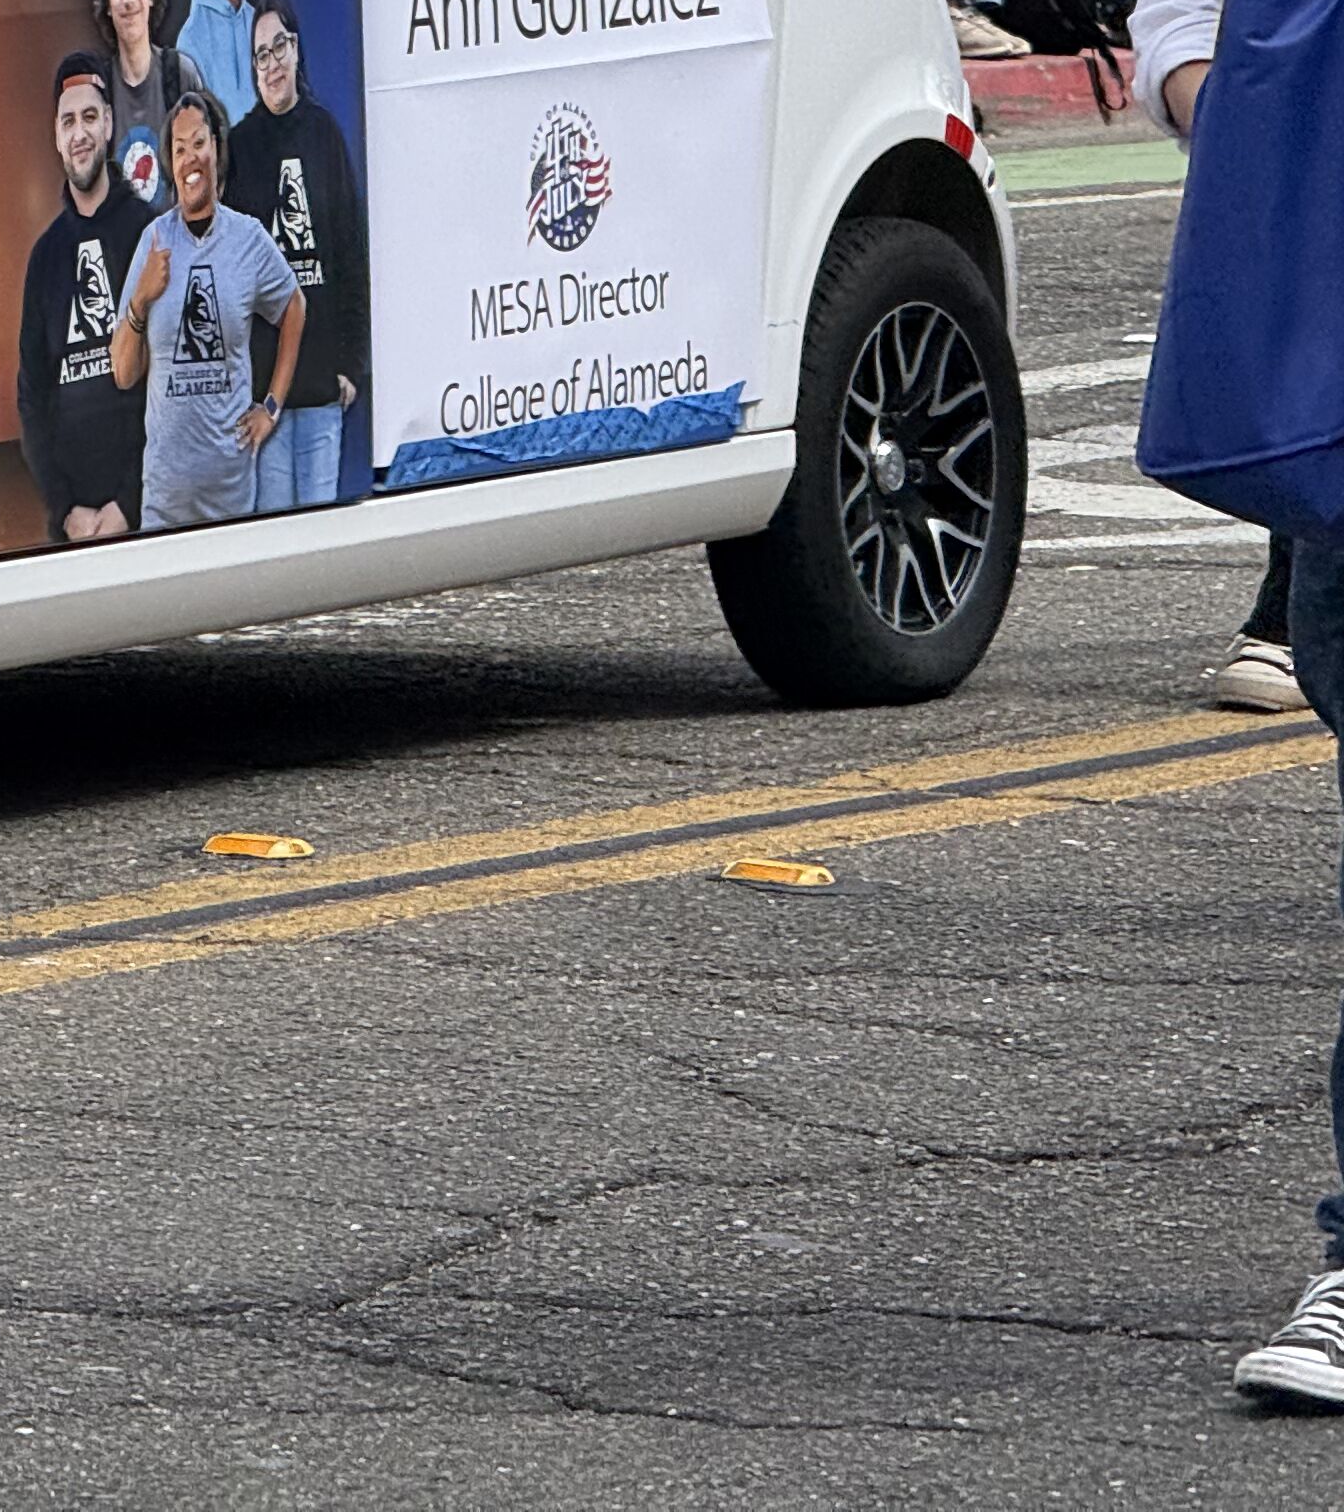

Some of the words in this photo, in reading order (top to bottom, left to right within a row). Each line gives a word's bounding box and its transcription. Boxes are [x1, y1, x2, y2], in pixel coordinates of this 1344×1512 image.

[539, 169, 590, 227] JULY
[471, 278, 554, 341] MESA
[560, 267, 670, 326] Director
[59, 357, 115, 385] ALAME
[69, 346, 108, 365] COLLEGE
[165, 369, 233, 398] ALAMEDA
[441, 374, 545, 435] College
[552, 358, 583, 417] of
[585, 340, 708, 411] Alameda
